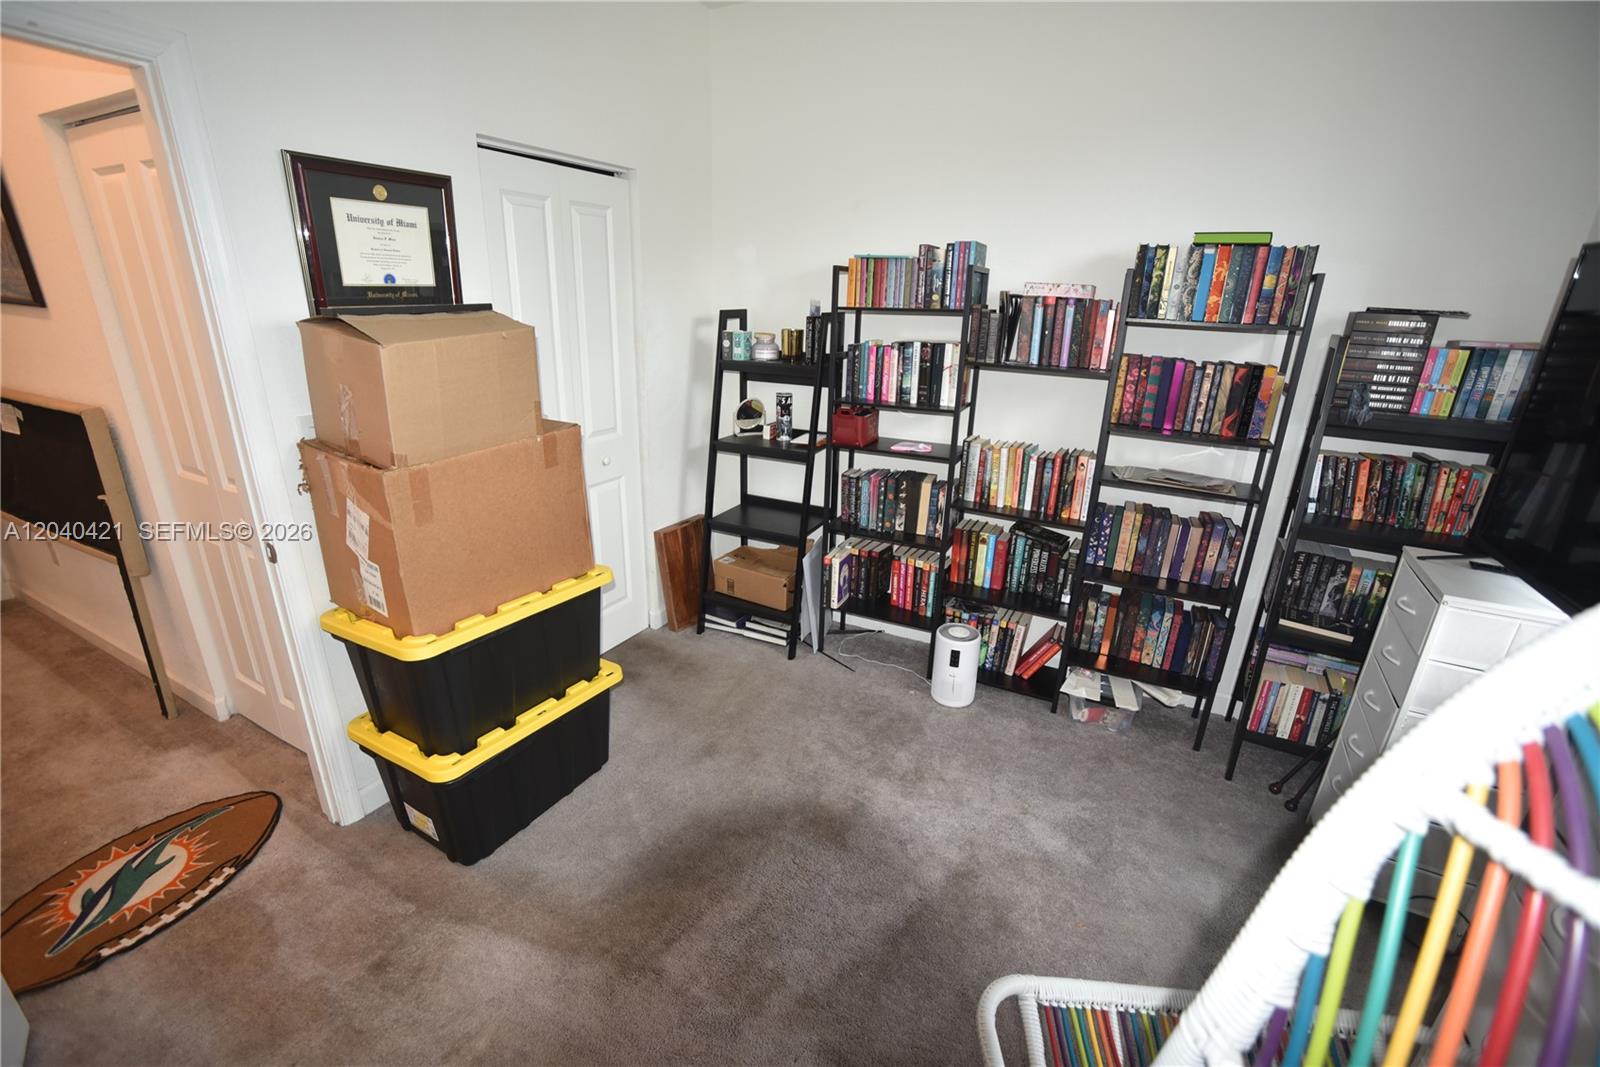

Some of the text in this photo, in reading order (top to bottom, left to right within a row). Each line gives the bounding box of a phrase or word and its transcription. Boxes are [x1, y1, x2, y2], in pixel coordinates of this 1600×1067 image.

[345, 213, 385, 227] University
[386, 218, 394, 226] of
[396, 218, 418, 229] Miami
